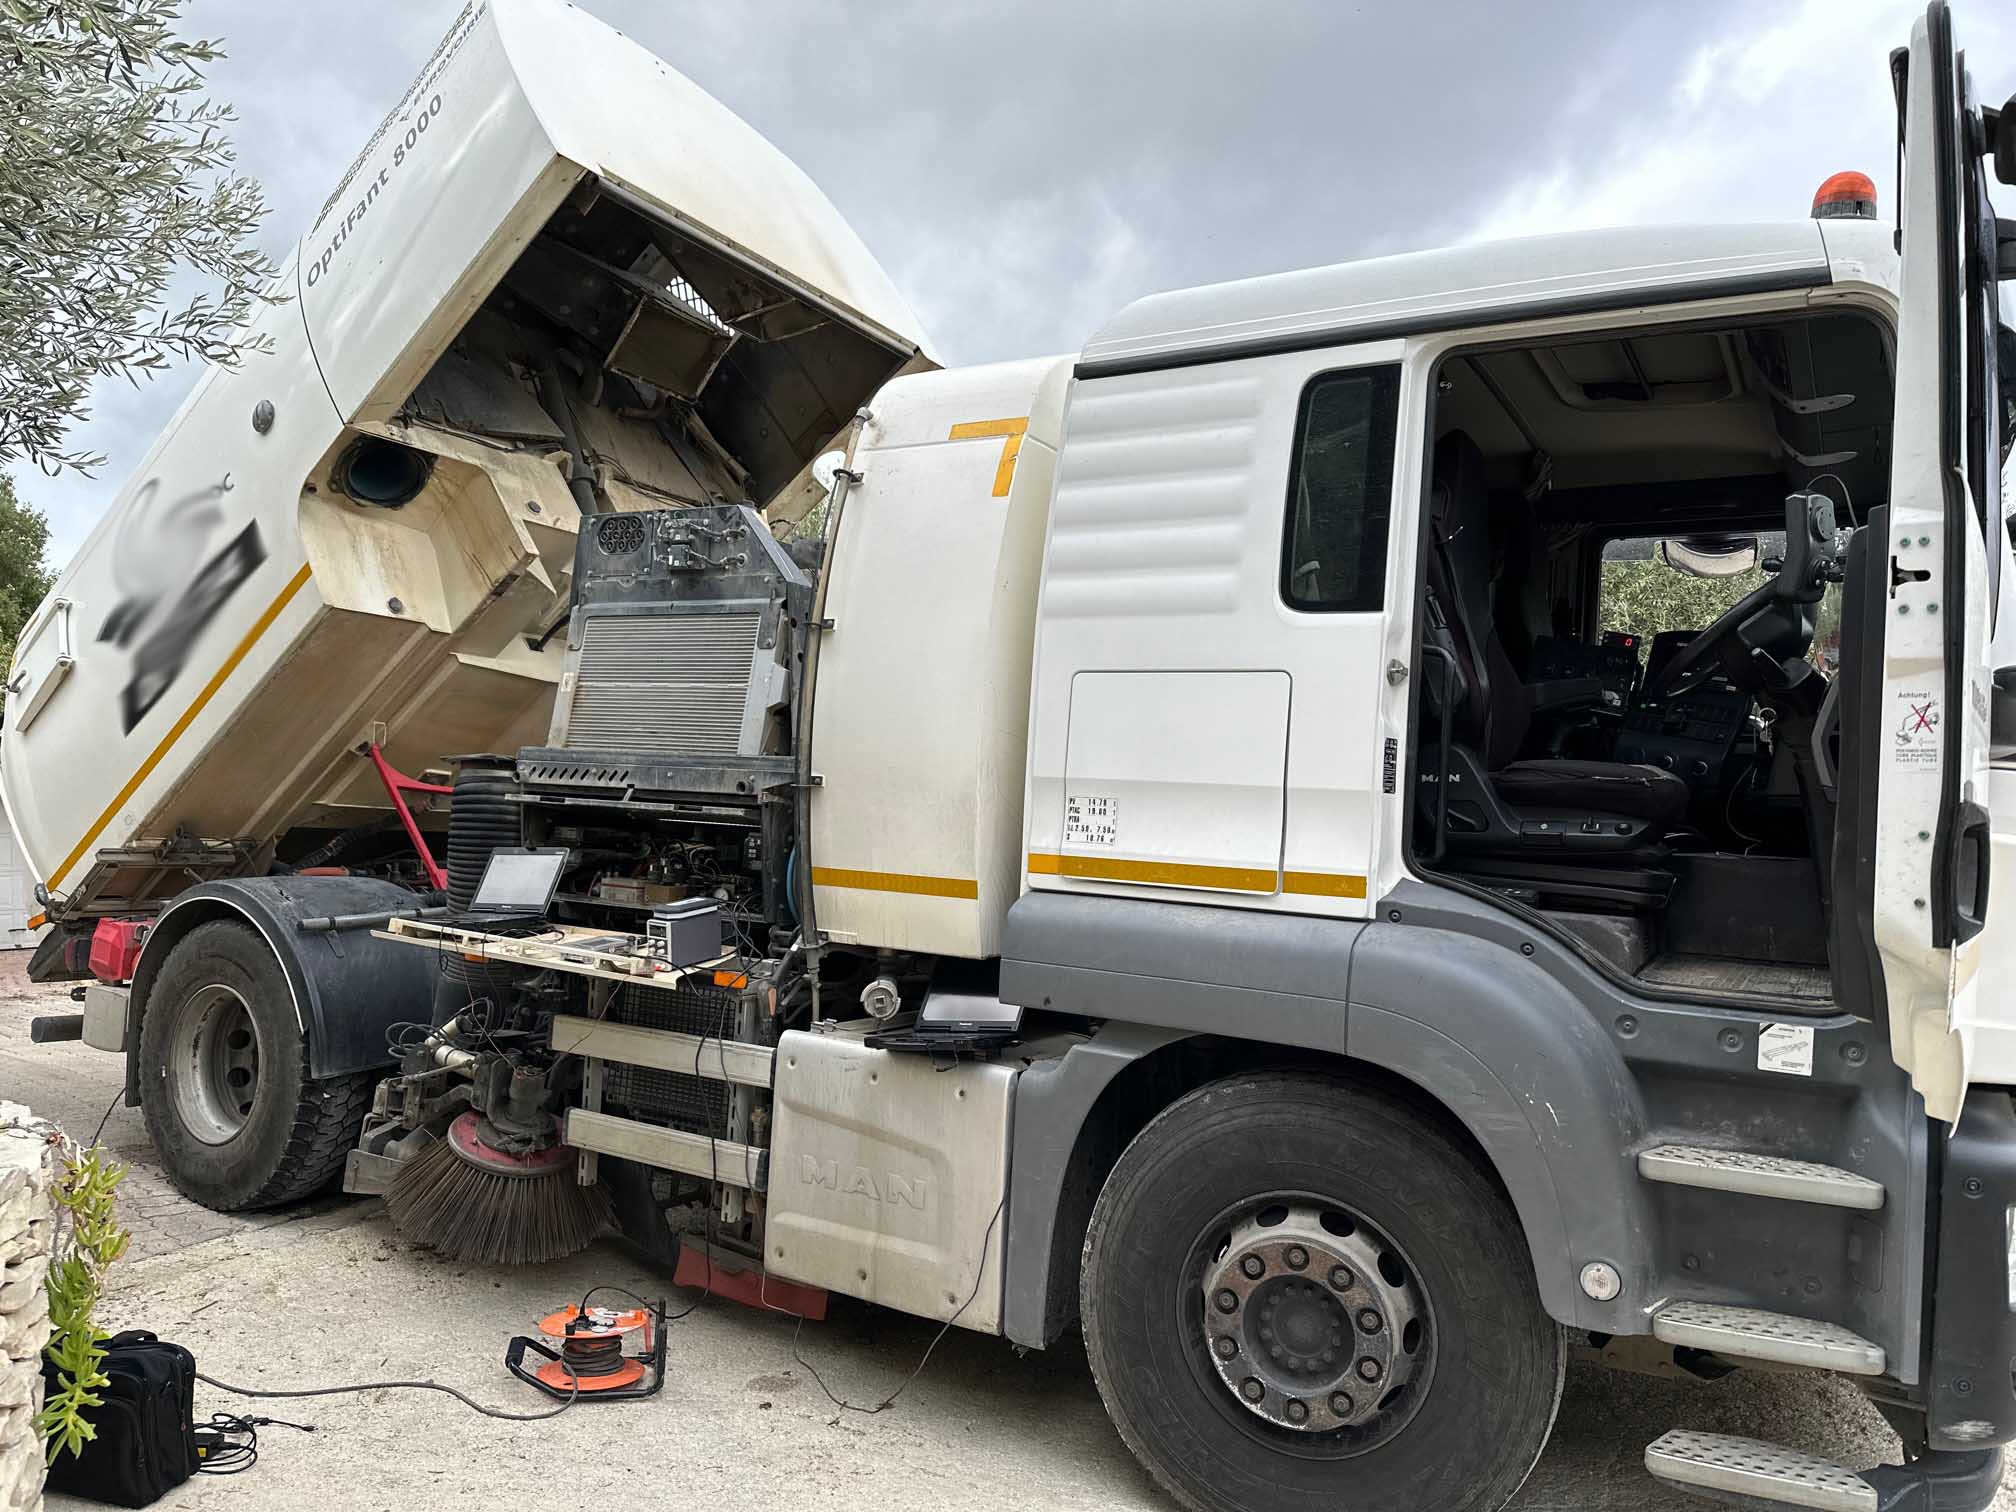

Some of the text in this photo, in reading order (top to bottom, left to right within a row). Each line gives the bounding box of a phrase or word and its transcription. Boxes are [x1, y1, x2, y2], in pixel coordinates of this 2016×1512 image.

[307, 94, 441, 288] OptiFant 8000
[1897, 691, 1931, 699] Achtung!
[800, 1154, 927, 1210] MAN
